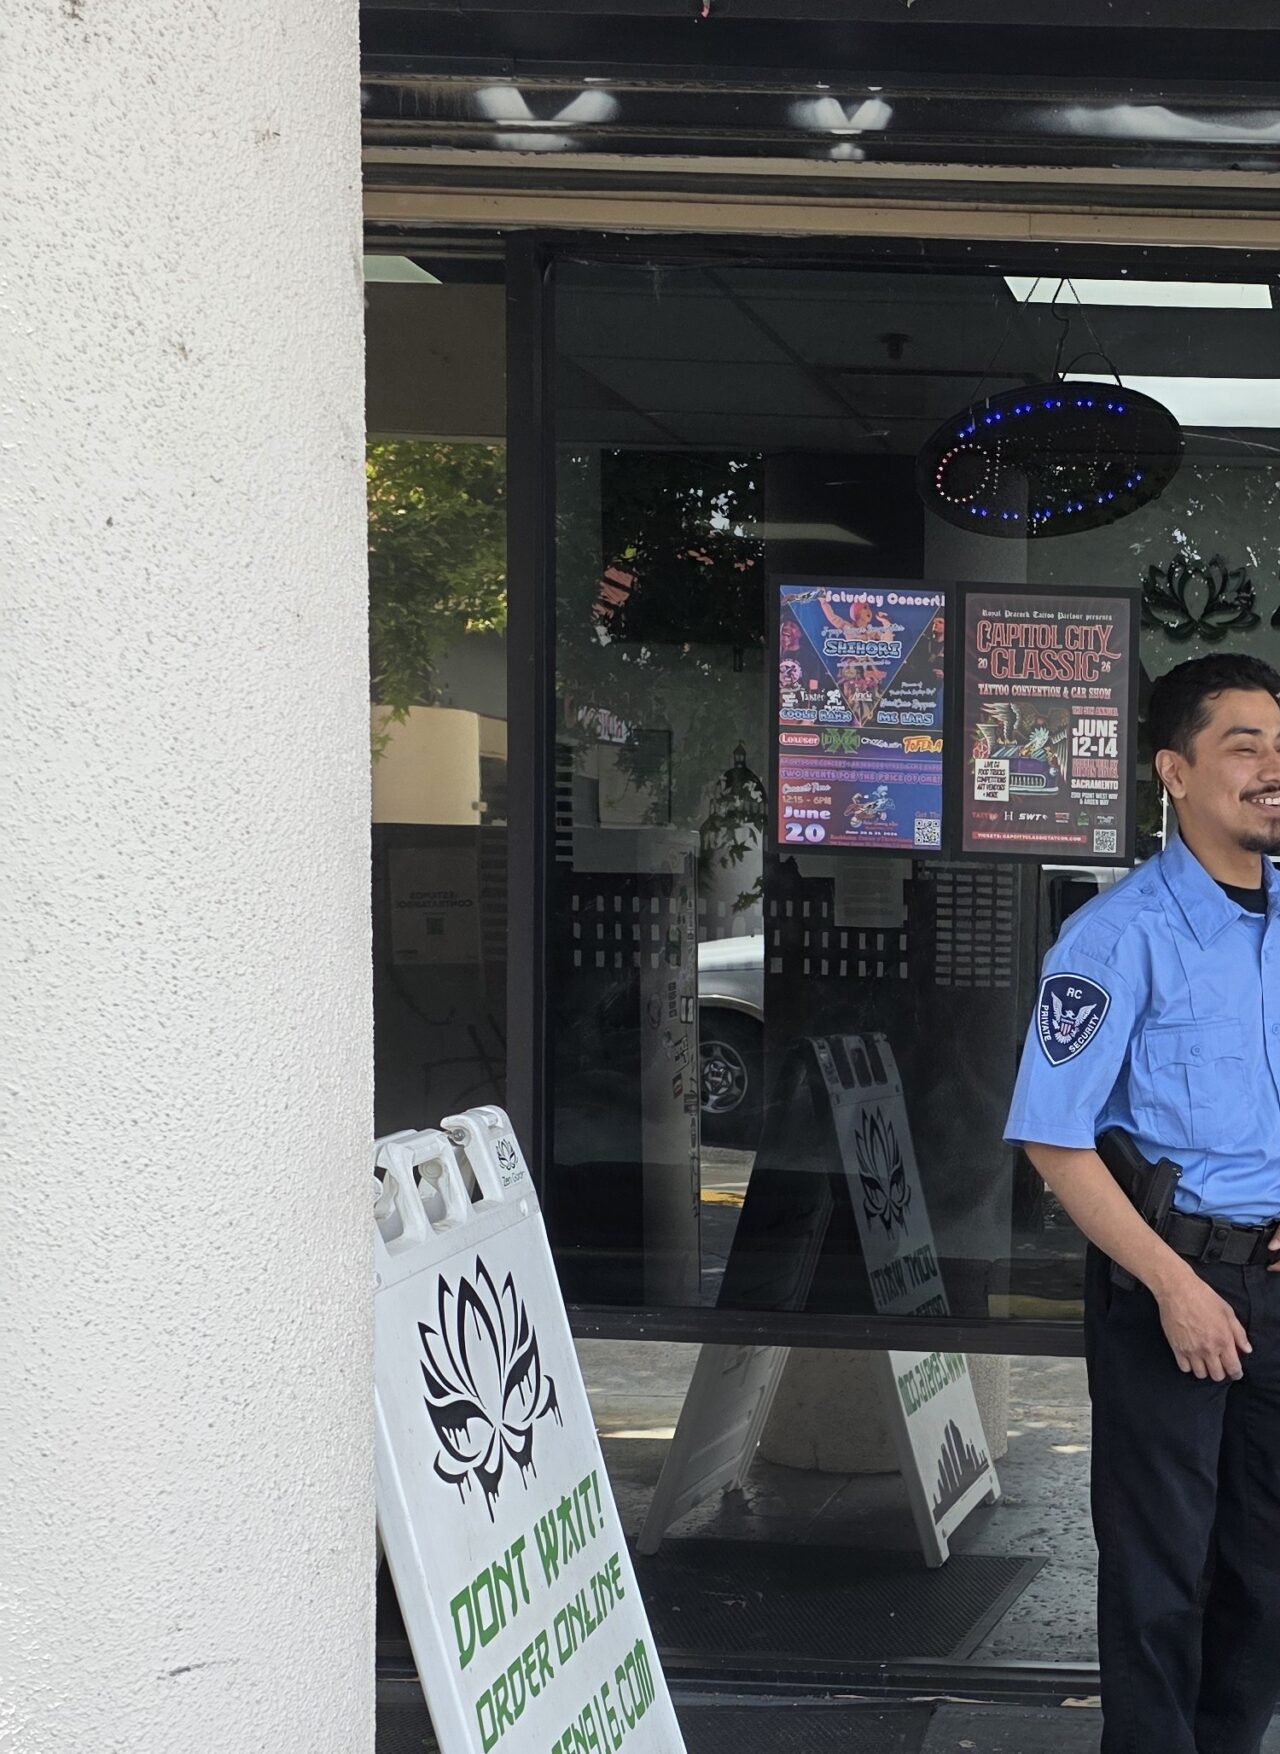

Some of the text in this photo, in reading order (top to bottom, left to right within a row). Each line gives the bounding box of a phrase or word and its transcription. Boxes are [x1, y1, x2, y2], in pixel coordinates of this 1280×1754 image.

[982, 609, 1001, 618] Royal
[1004, 610, 1030, 618] Peacock
[1033, 610, 1055, 619] Tattoo
[1085, 613, 1112, 621] presents
[824, 639, 902, 658] SHIHORI
[977, 620, 1122, 659] CAPITOL CITY
[977, 648, 1111, 682] 20 CLASSIC 26
[978, 683, 1112, 700] TATTOO CONVENTION & CAR SHOW
[1072, 719, 1118, 738] JUNE
[1072, 737, 1118, 757] 12-14
[781, 770, 802, 778] TWO
[803, 771, 836, 779] EVENTS
[839, 773, 856, 781] FOR
[859, 773, 876, 781] THE
[878, 774, 904, 782] PRICE
[1071, 779, 1119, 790] SACRAMENTO
[813, 796, 832, 806] 6PM
[784, 806, 831, 820] June
[1019, 813, 1041, 821] SWT
[785, 823, 826, 842] 20
[1066, 986, 1083, 1000] RC
[1041, 1004, 1052, 1041] PRIVATE
[1068, 1013, 1100, 1053] SECURITY
[450, 1469, 604, 1671] DONT WAIT!
[475, 1552, 625, 1754] ORDER ONLINE
